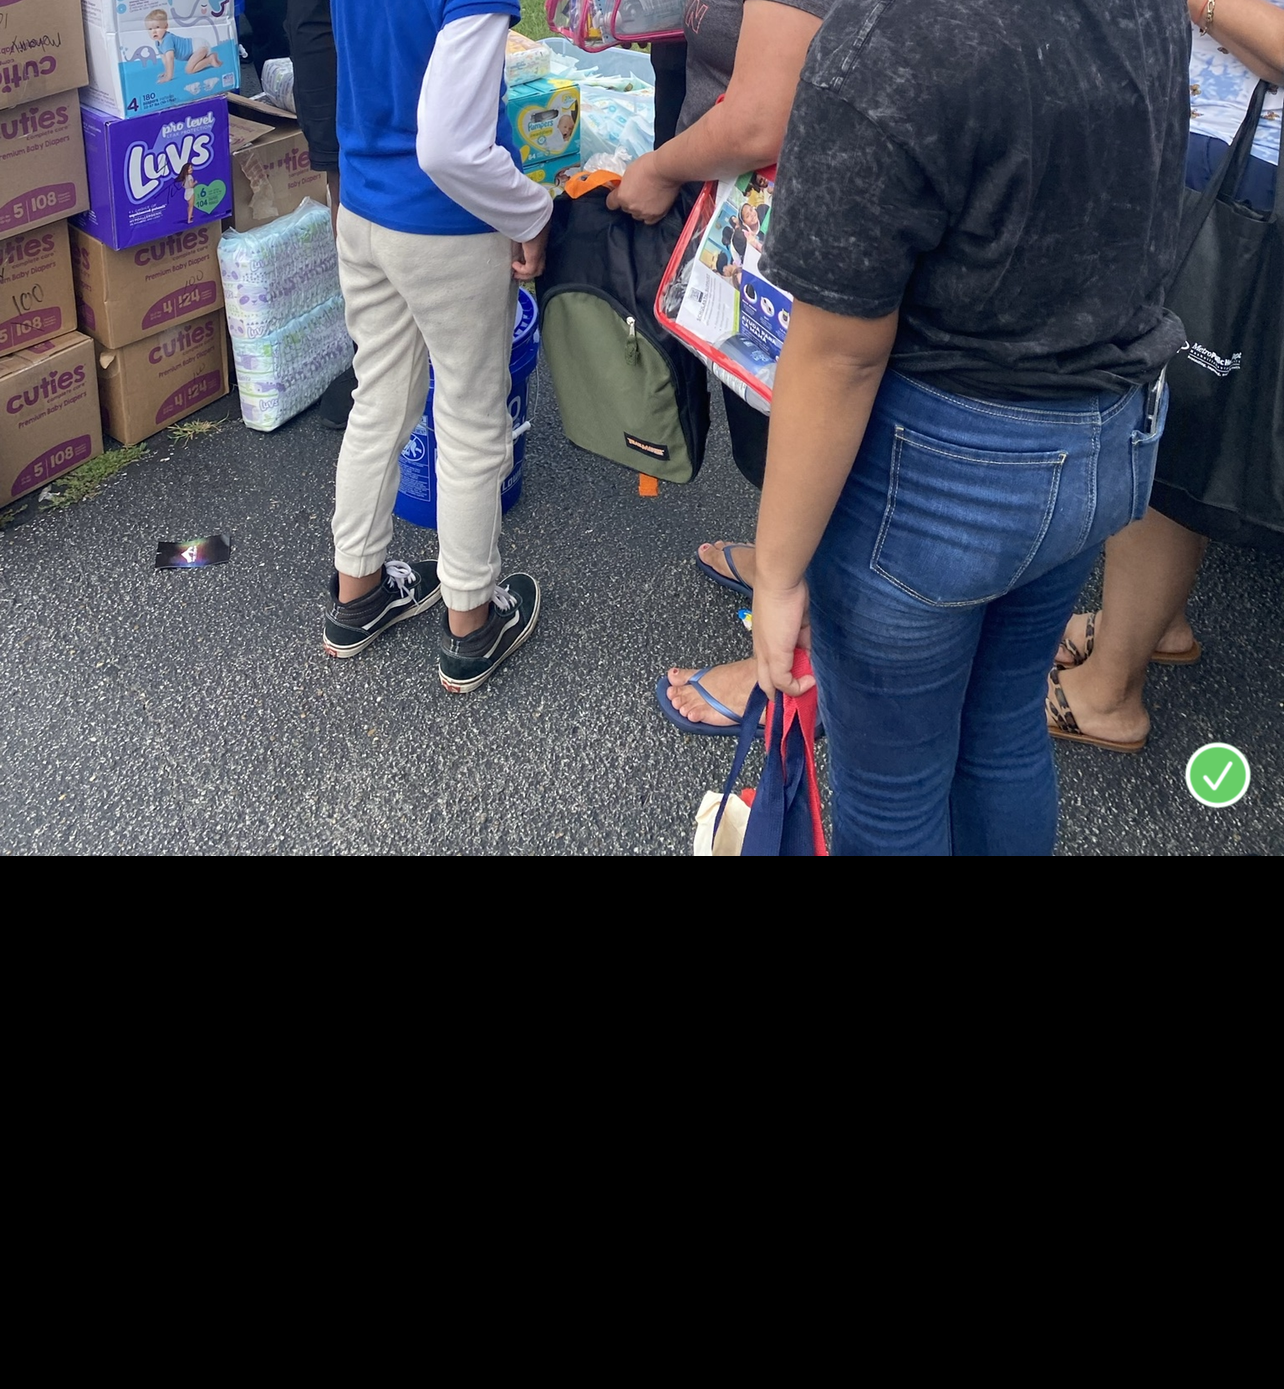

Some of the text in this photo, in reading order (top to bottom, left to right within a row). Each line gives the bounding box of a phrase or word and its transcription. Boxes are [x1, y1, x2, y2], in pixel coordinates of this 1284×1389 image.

[0, 55, 57, 93] cuti
[127, 97, 139, 111] 4
[142, 92, 155, 102] 180
[0, 106, 69, 140] uties
[162, 111, 215, 138] pro level
[528, 120, 554, 132] Pampers
[0, 135, 70, 161] remium Baby Diapers
[128, 134, 211, 200] Luvs
[13, 191, 58, 219] 5 108
[196, 199, 208, 208] 104
[200, 187, 207, 198] 6
[0, 233, 55, 266] ties
[134, 227, 209, 267] cuties
[12, 270, 30, 281] Baby
[30, 261, 57, 274] Diapers
[145, 253, 210, 282] Premium Baby Diapers
[12, 283, 44, 317] 100
[162, 288, 201, 314] 4 124
[15, 315, 42, 337] 108
[149, 320, 215, 365] cuties
[158, 345, 215, 379] Premium Baby Diapers
[6, 363, 87, 415] cuties
[174, 379, 208, 407] 4 124
[18, 390, 88, 430] Premium Baby Diapers
[33, 445, 75, 478] 5 108
